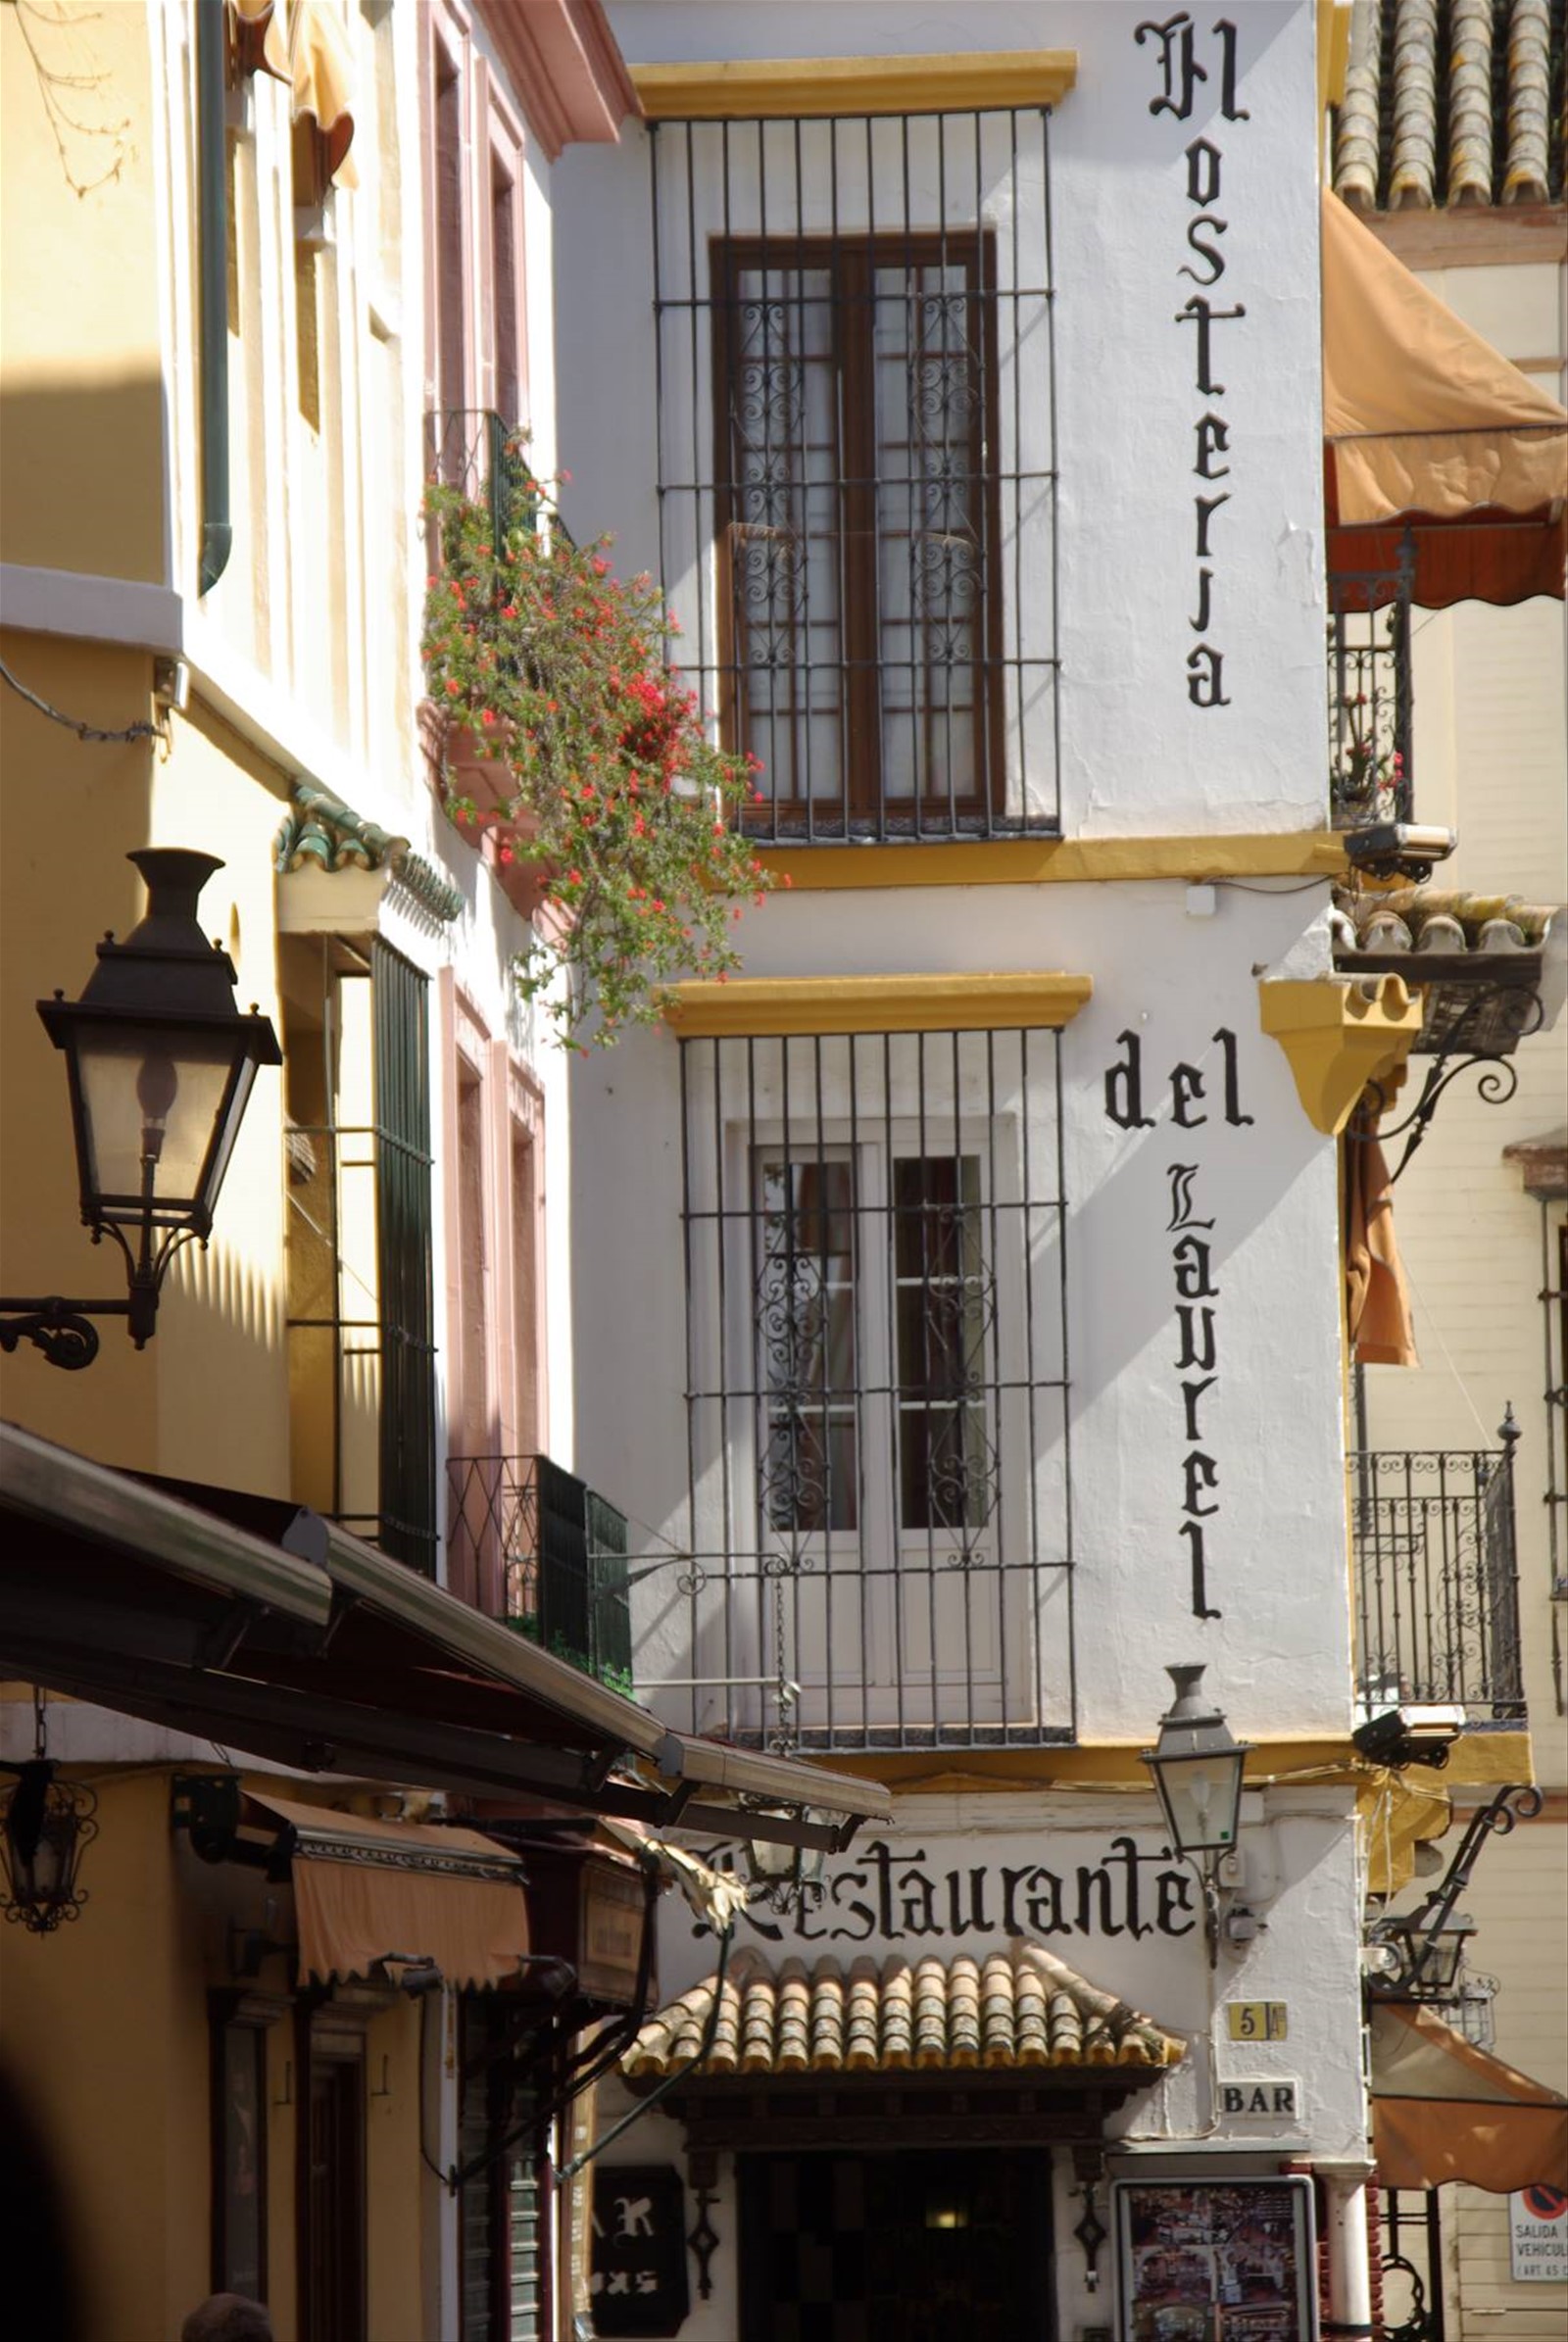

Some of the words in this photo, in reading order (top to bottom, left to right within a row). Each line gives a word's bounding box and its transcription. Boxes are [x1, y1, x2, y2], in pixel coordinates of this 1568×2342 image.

[1104, 1027, 1254, 1129] del
[1165, 1163, 1220, 1620] Laurel
[1241, 2007, 1255, 2035] 5
[1223, 2086, 1295, 2112] BAR
[1515, 2224, 1558, 2238] SALIDA
